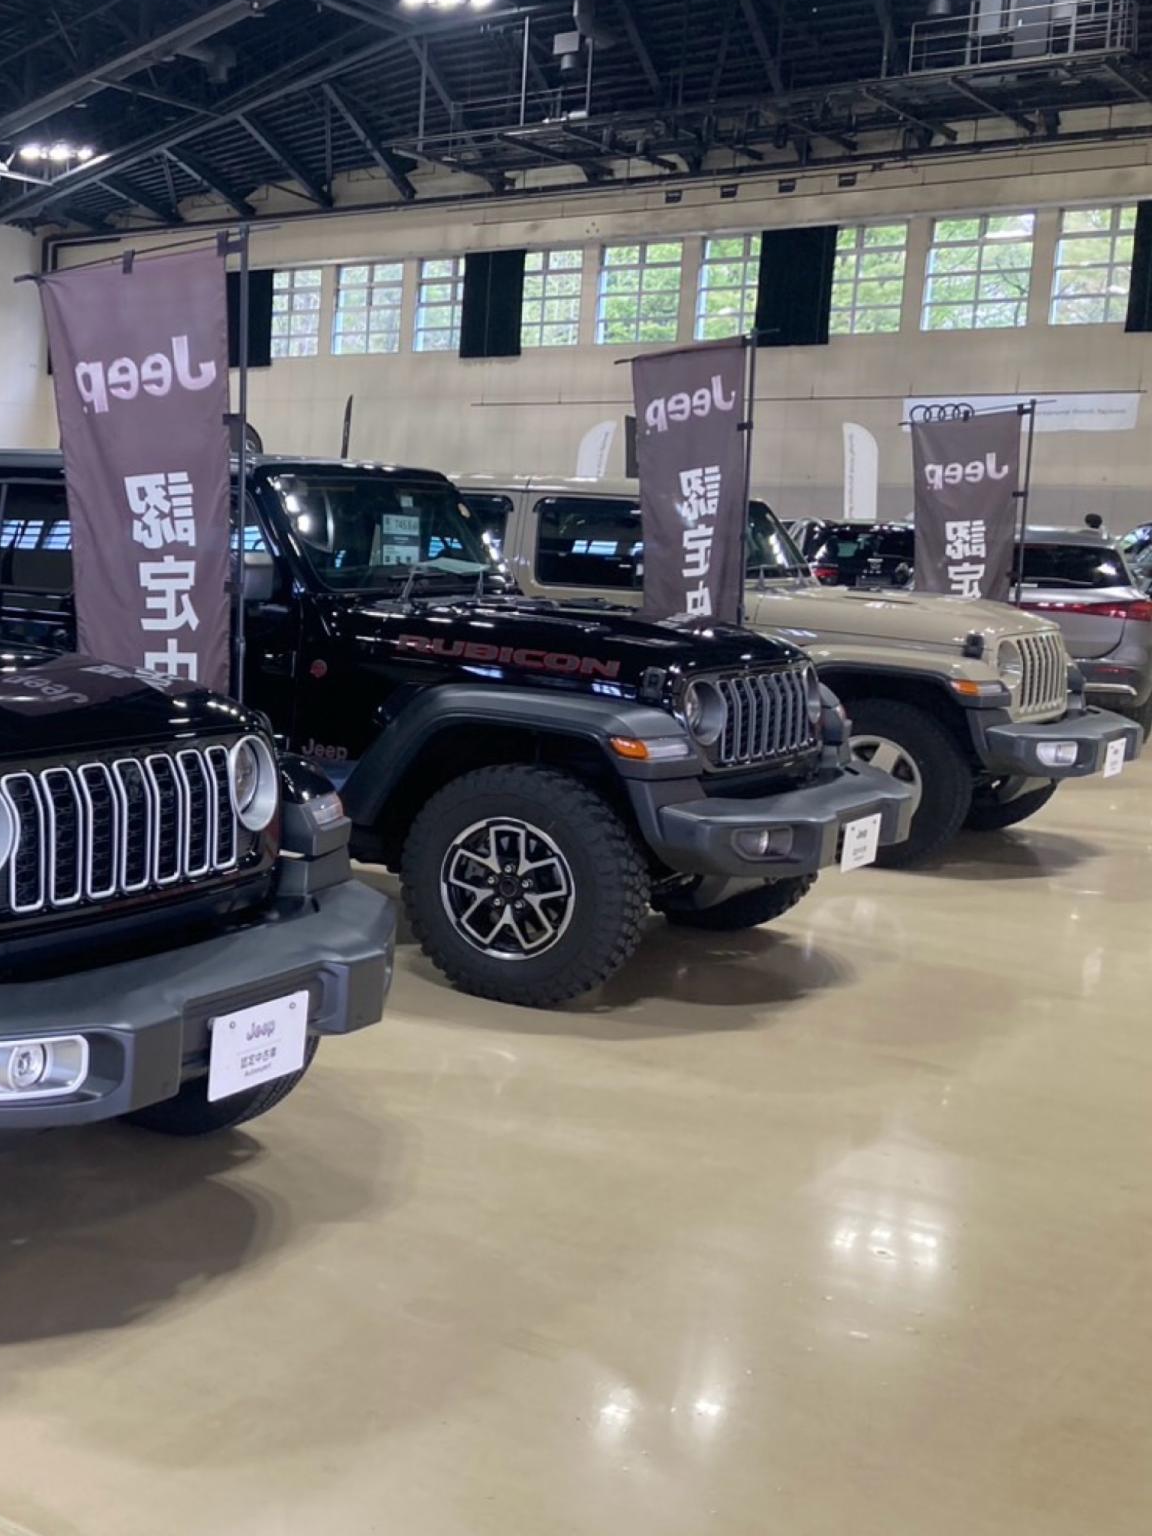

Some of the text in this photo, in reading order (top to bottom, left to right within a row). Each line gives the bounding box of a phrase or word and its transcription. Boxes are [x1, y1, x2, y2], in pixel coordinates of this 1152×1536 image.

[397, 634, 621, 678] RUBICON
[301, 738, 348, 762] Jeep
[246, 1020, 276, 1041] Jeep
